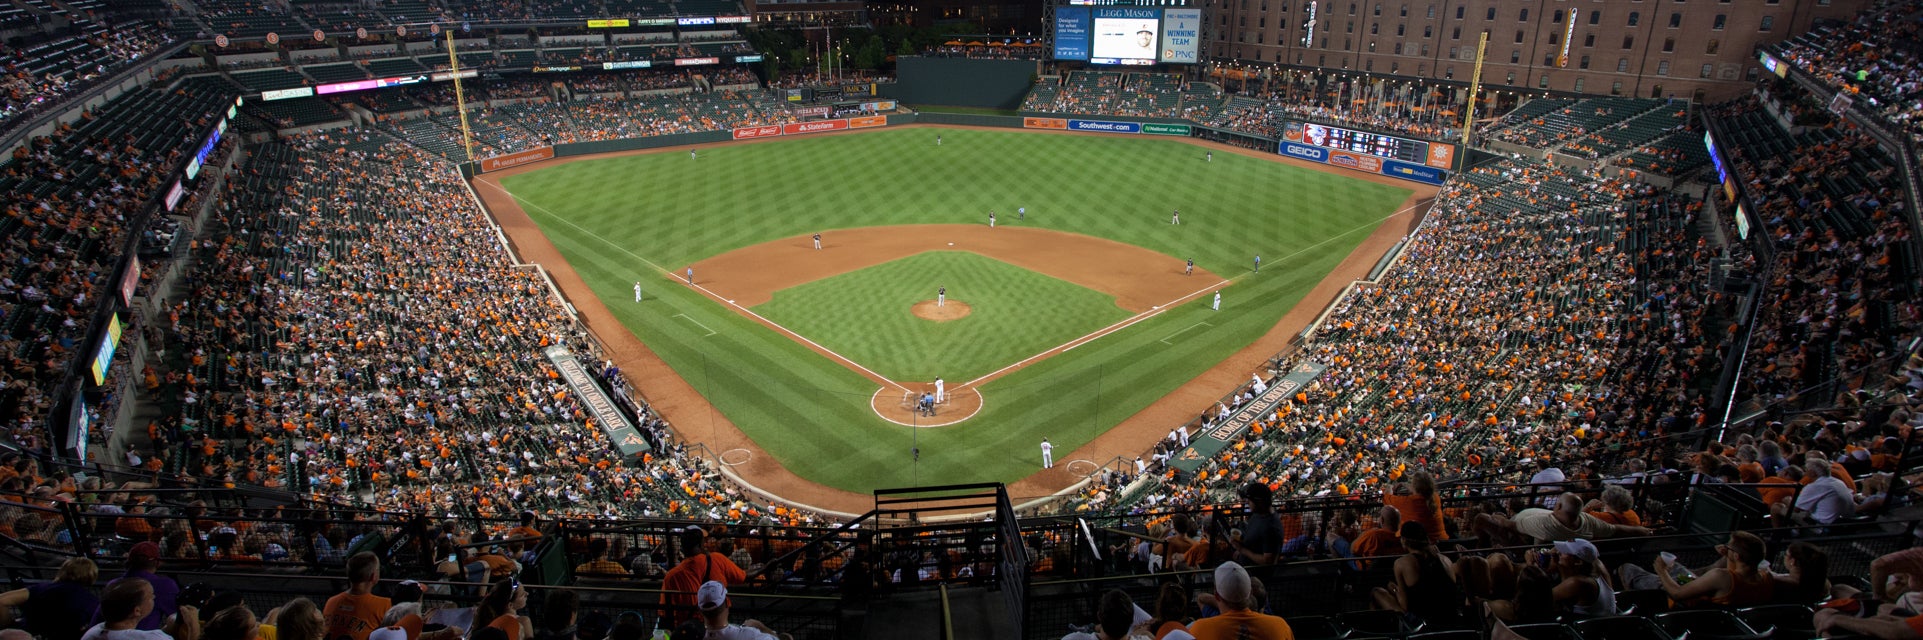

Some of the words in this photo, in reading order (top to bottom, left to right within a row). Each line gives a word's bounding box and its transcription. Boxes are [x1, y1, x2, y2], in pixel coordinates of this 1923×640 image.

[1100, 9, 1122, 17] LEGG
[1123, 9, 1154, 18] MASON
[1172, 38, 1190, 46] TEAM
[1175, 50, 1194, 59] PNC
[1287, 145, 1321, 159] GEICO
[1413, 169, 1434, 179] MedStar
[580, 383, 595, 394] TO
[586, 391, 613, 415] ORIOLE
[1212, 417, 1243, 440] HOME
[1236, 409, 1255, 423] OF
[1250, 399, 1270, 414] THE
[1262, 379, 1298, 402] ORIOLES
[602, 410, 626, 431] PARK
